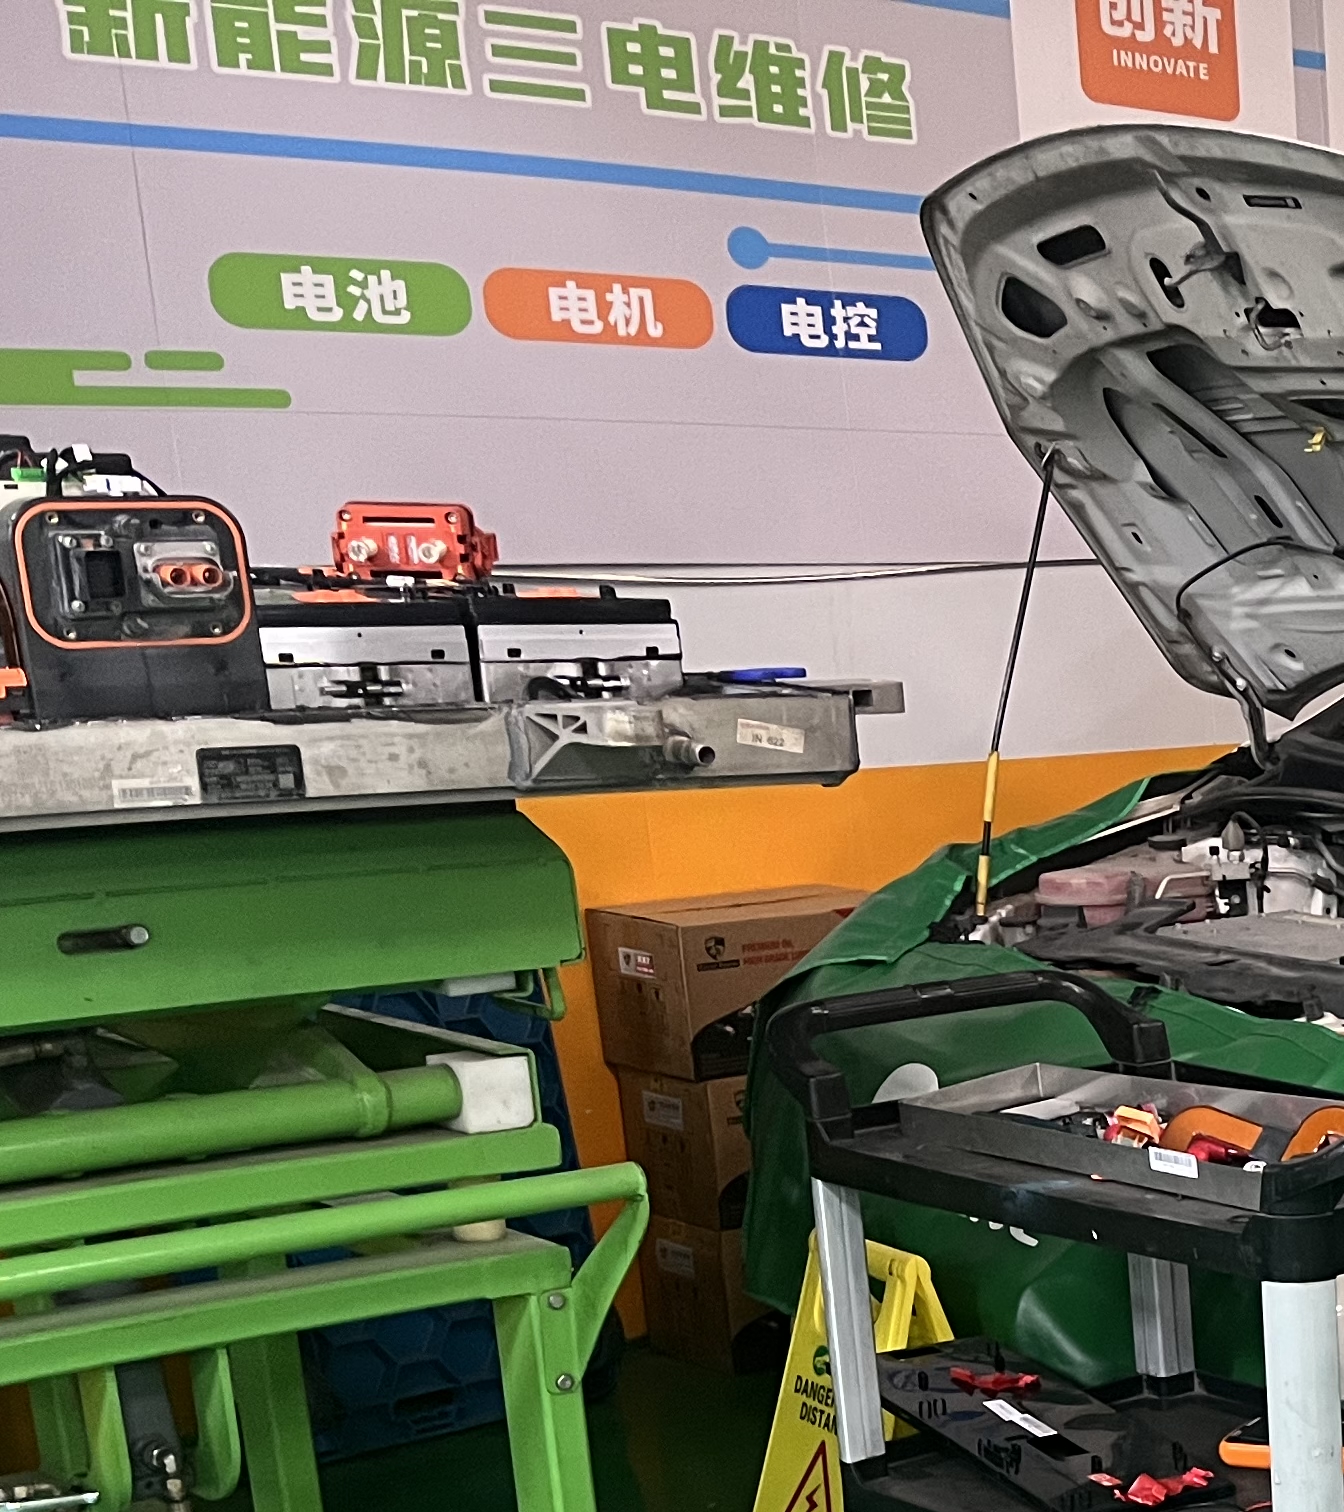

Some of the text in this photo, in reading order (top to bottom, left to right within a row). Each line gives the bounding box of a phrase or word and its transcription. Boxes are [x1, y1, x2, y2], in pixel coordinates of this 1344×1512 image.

[1100, 0, 1222, 55] 创新
[1112, 48, 1209, 81] INNOVATE
[280, 265, 411, 325] 电池
[547, 280, 664, 338] 电机
[780, 297, 882, 351] 电控
[794, 1374, 835, 1409] DANGE
